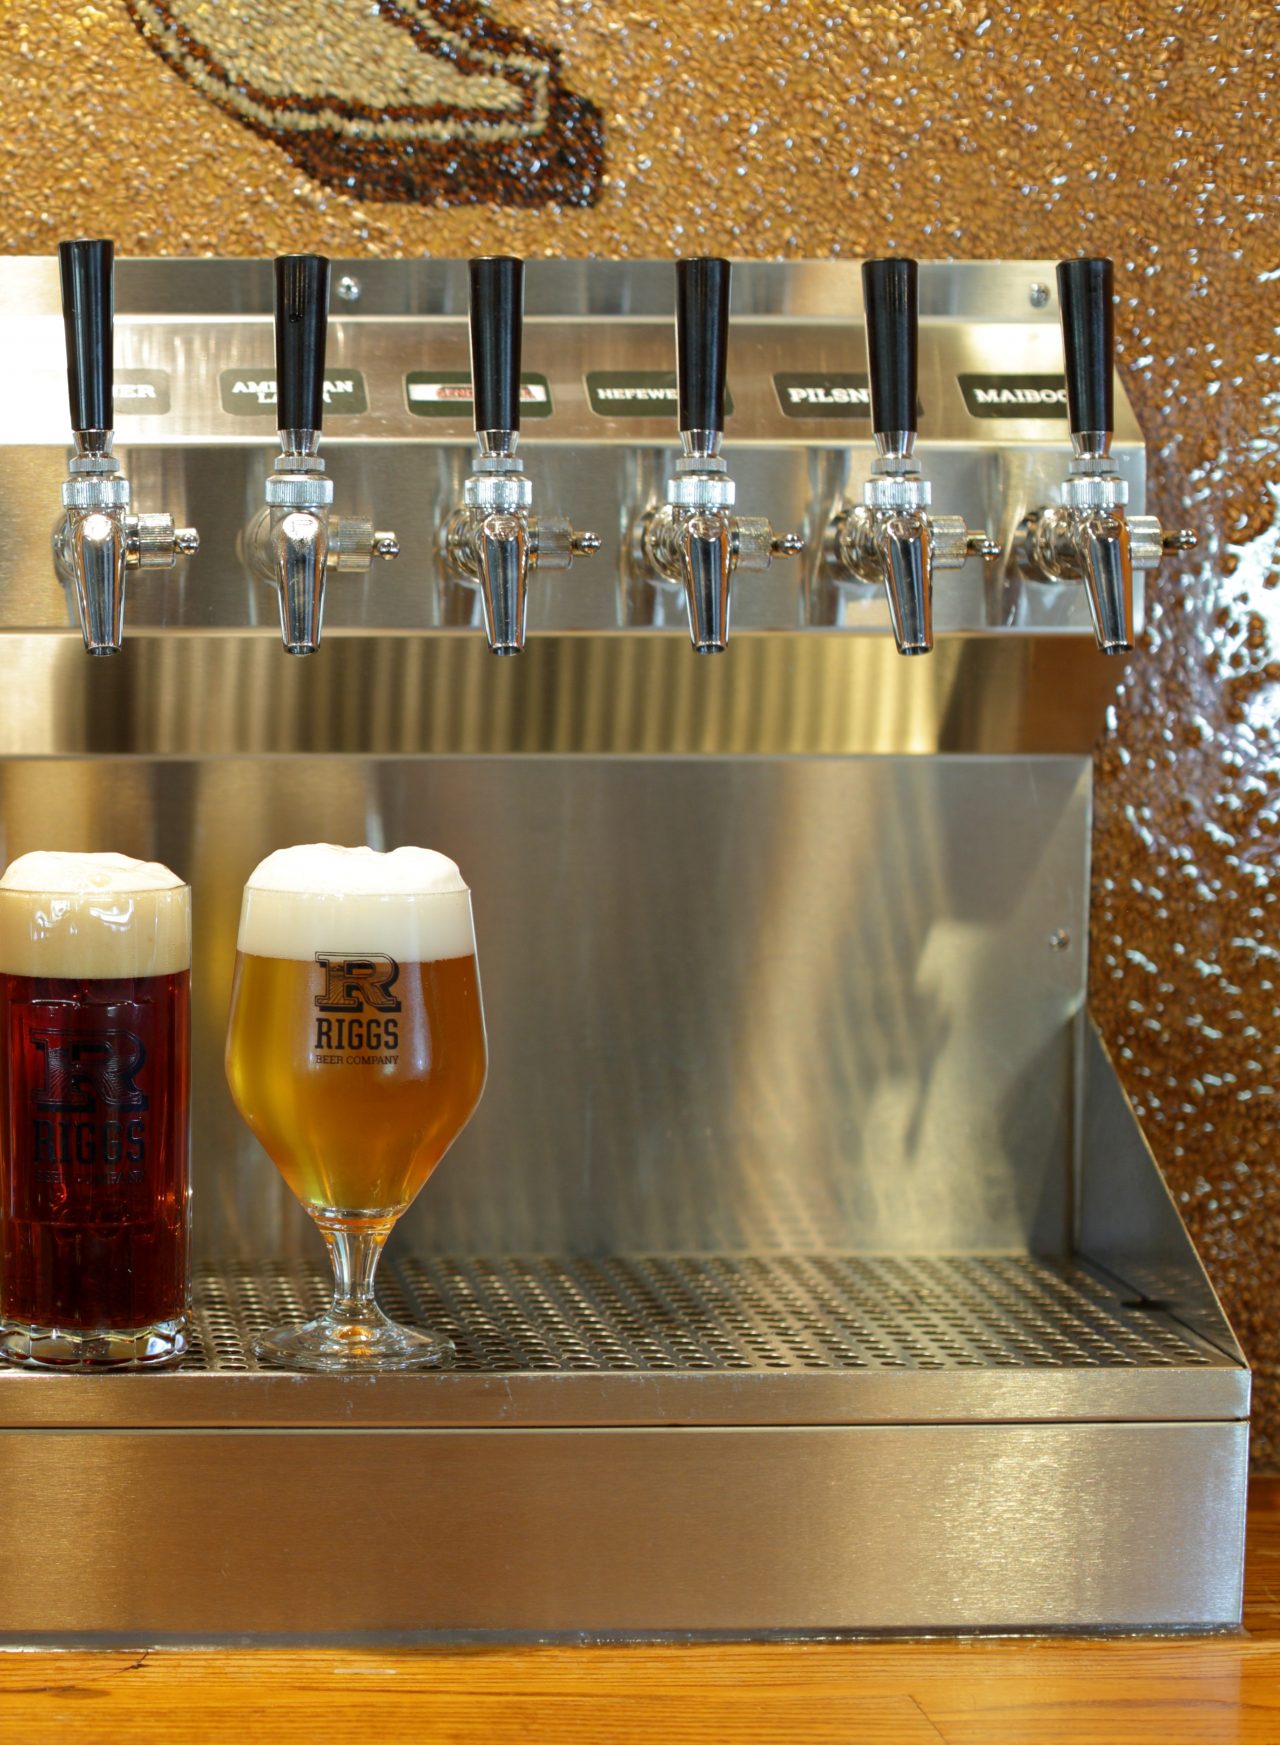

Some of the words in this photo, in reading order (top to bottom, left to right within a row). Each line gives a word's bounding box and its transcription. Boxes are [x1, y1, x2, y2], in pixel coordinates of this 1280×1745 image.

[597, 388, 678, 400] HEFEWE
[787, 387, 870, 403] PILSN
[315, 1018, 398, 1050] RIGGS
[315, 1055, 344, 1065] BEER
[346, 1055, 399, 1065] COMPANY
[34, 1119, 145, 1165] RIGGS
